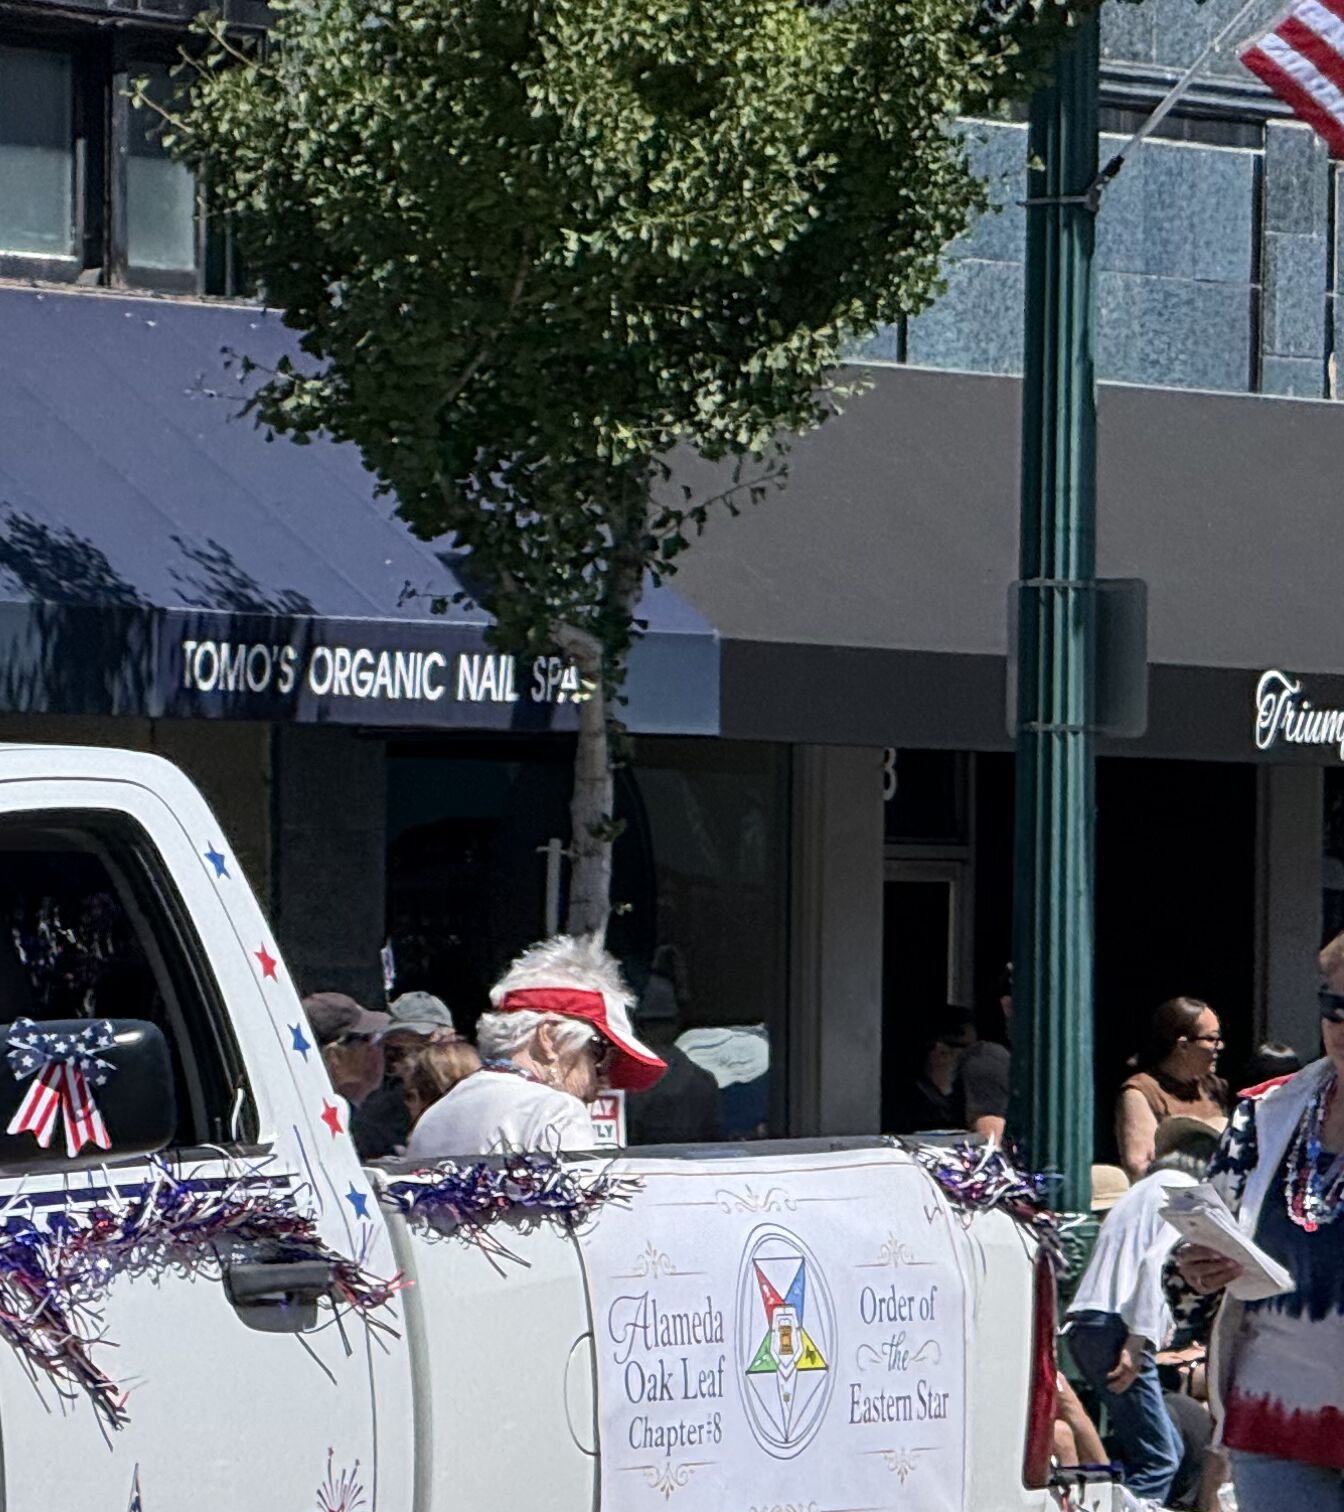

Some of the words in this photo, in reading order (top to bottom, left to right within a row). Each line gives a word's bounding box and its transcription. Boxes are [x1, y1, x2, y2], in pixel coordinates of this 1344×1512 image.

[183, 640, 298, 694] TOMO'S
[309, 645, 447, 701] ORGANIC
[457, 654, 519, 702] NAIL
[608, 1290, 725, 1364] Alameda
[860, 1284, 915, 1325] Order
[919, 1285, 938, 1321] of
[881, 1330, 909, 1371] the
[625, 1359, 674, 1404] Oak
[681, 1355, 725, 1400] Leaf
[849, 1382, 913, 1424] Eastern
[916, 1379, 950, 1421] Star
